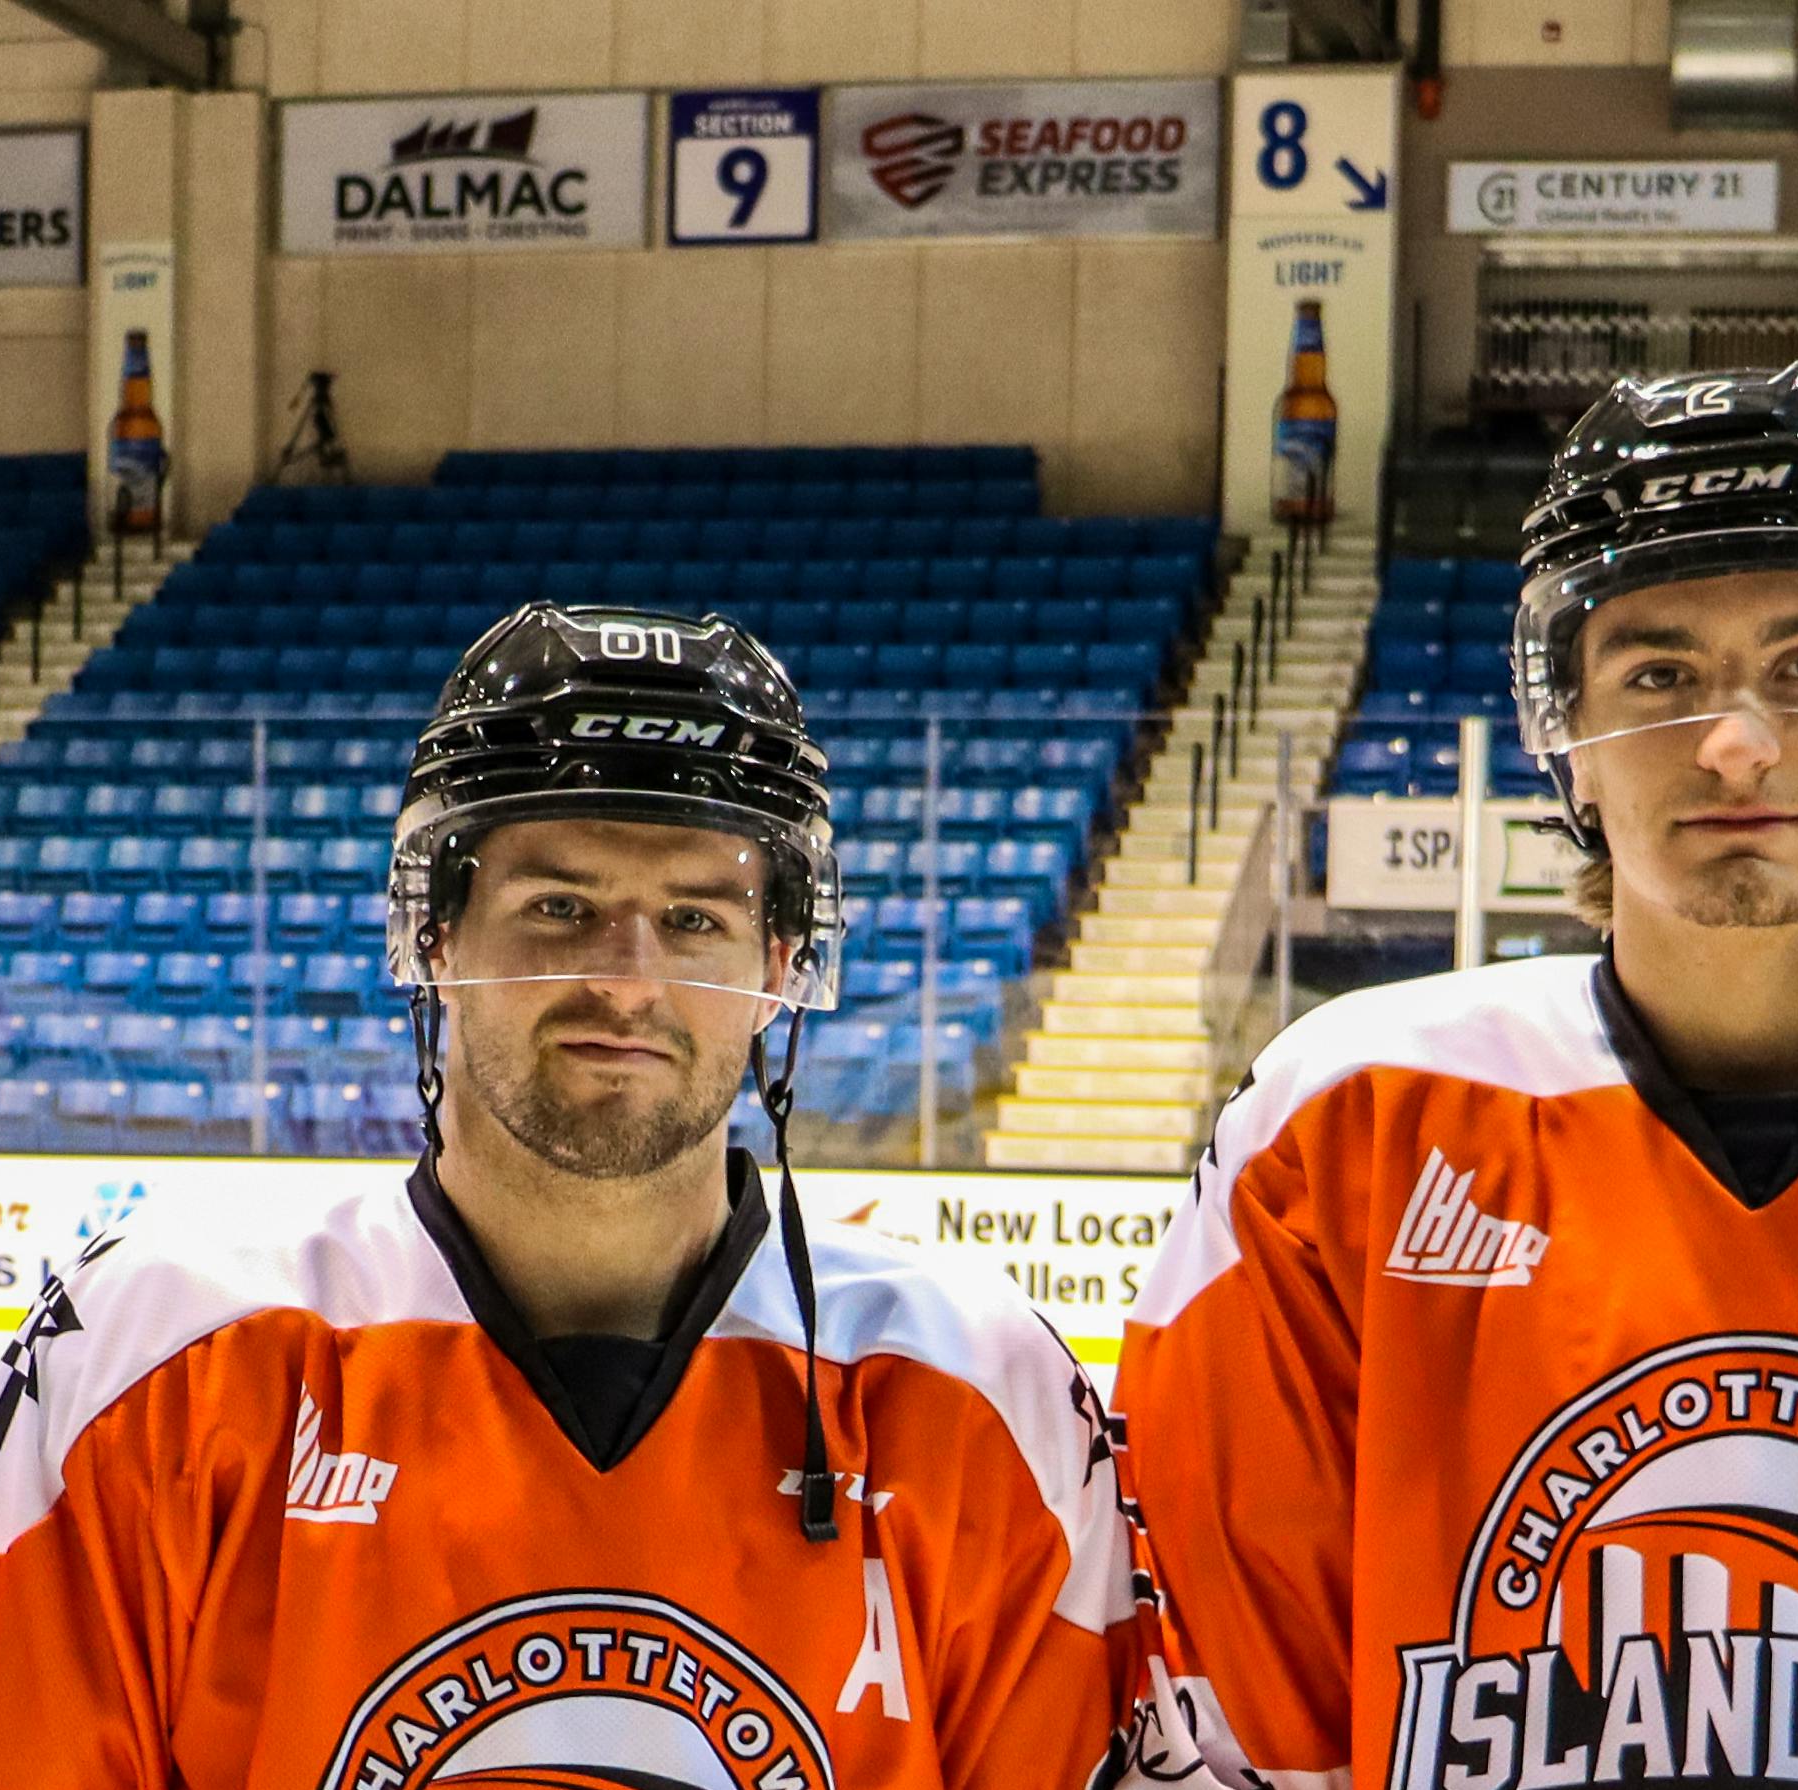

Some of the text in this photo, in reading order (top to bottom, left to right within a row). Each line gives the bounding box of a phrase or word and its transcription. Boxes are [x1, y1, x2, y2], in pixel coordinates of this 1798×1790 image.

[695, 115, 793, 137] SECTION
[976, 117, 1186, 156] SEAFOOD
[1257, 101, 1308, 190] 8
[335, 171, 587, 221] DALMAC
[717, 146, 768, 228] 9
[976, 158, 1180, 197] EXPRESS
[1536, 172, 1743, 199] CENTURY 21
[1275, 261, 1343, 285] LIGHT
[1640, 463, 1793, 504] CCM
[569, 712, 727, 748] CCM
[937, 1200, 1037, 1243] New
[835, 1557, 911, 1722] A
